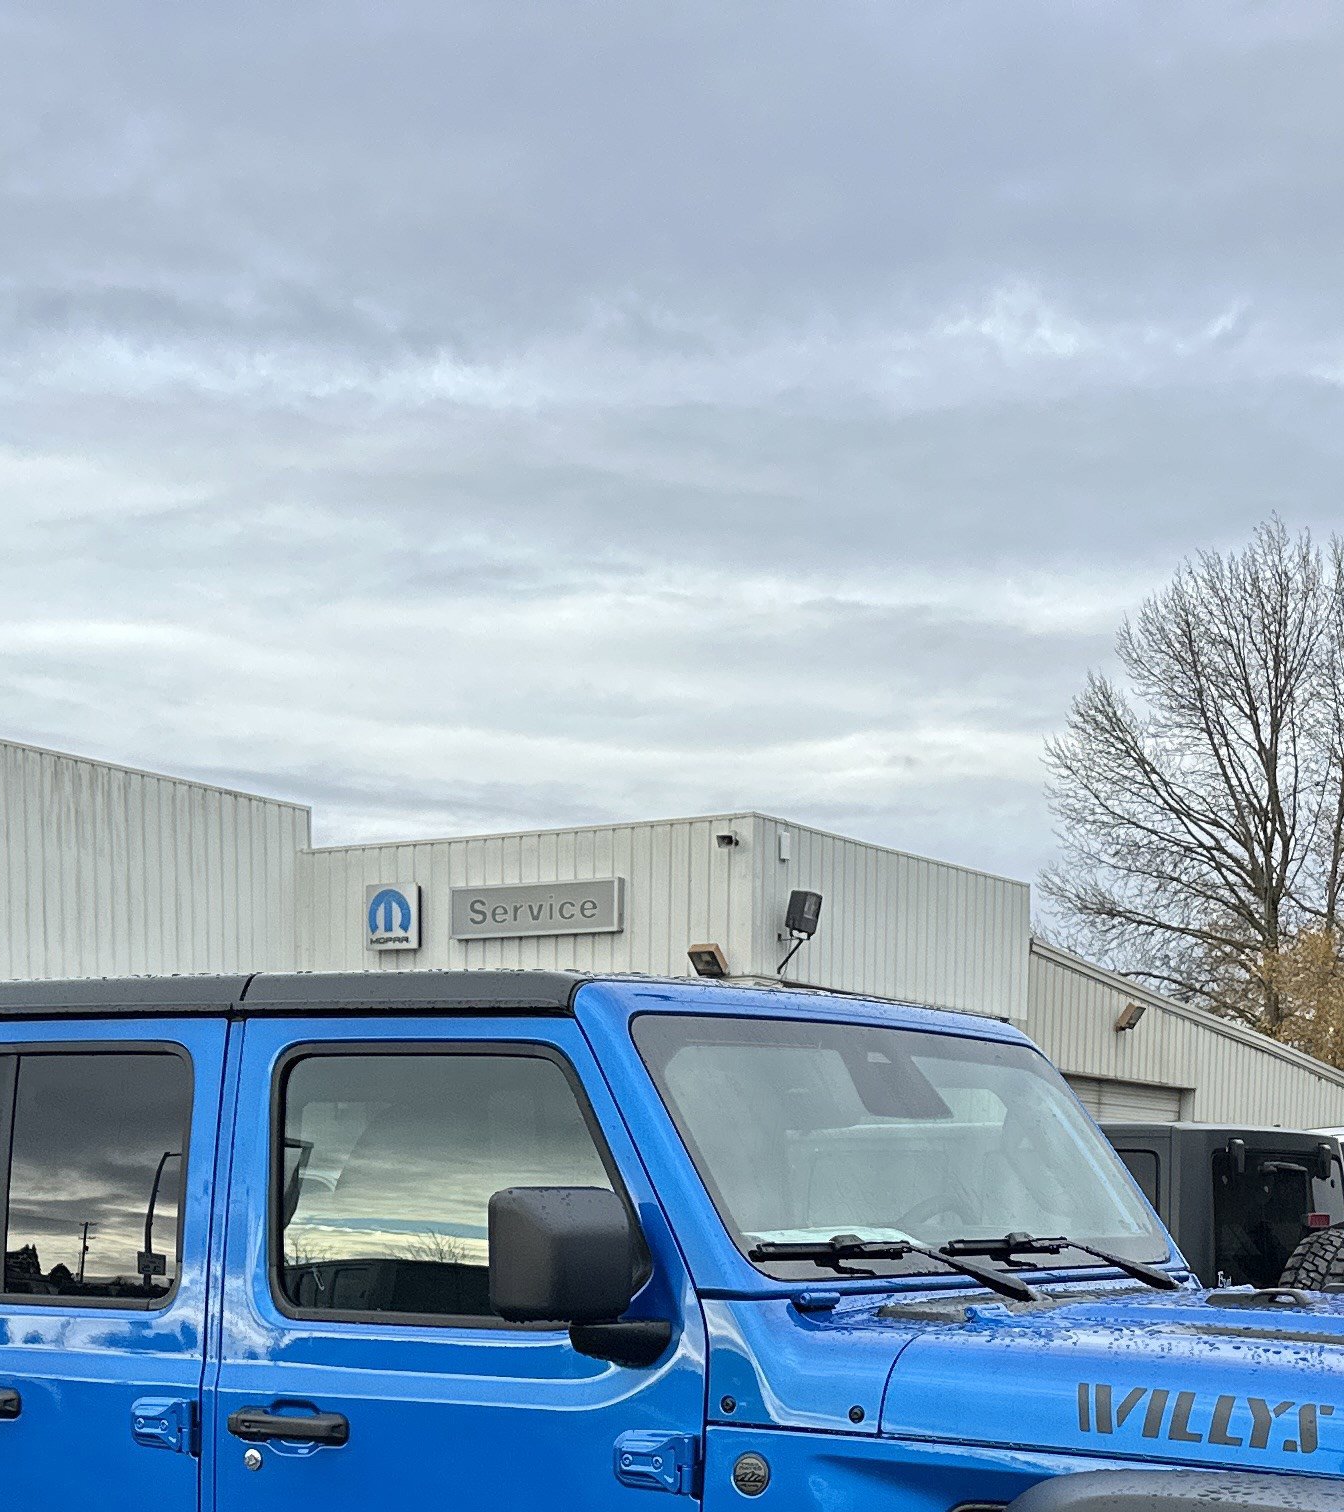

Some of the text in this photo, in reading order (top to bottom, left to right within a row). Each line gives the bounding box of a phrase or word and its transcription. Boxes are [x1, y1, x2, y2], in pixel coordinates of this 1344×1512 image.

[468, 894, 599, 926] Service
[368, 935, 410, 946] MOPAR
[1077, 1382, 1335, 1454] WILLYS
